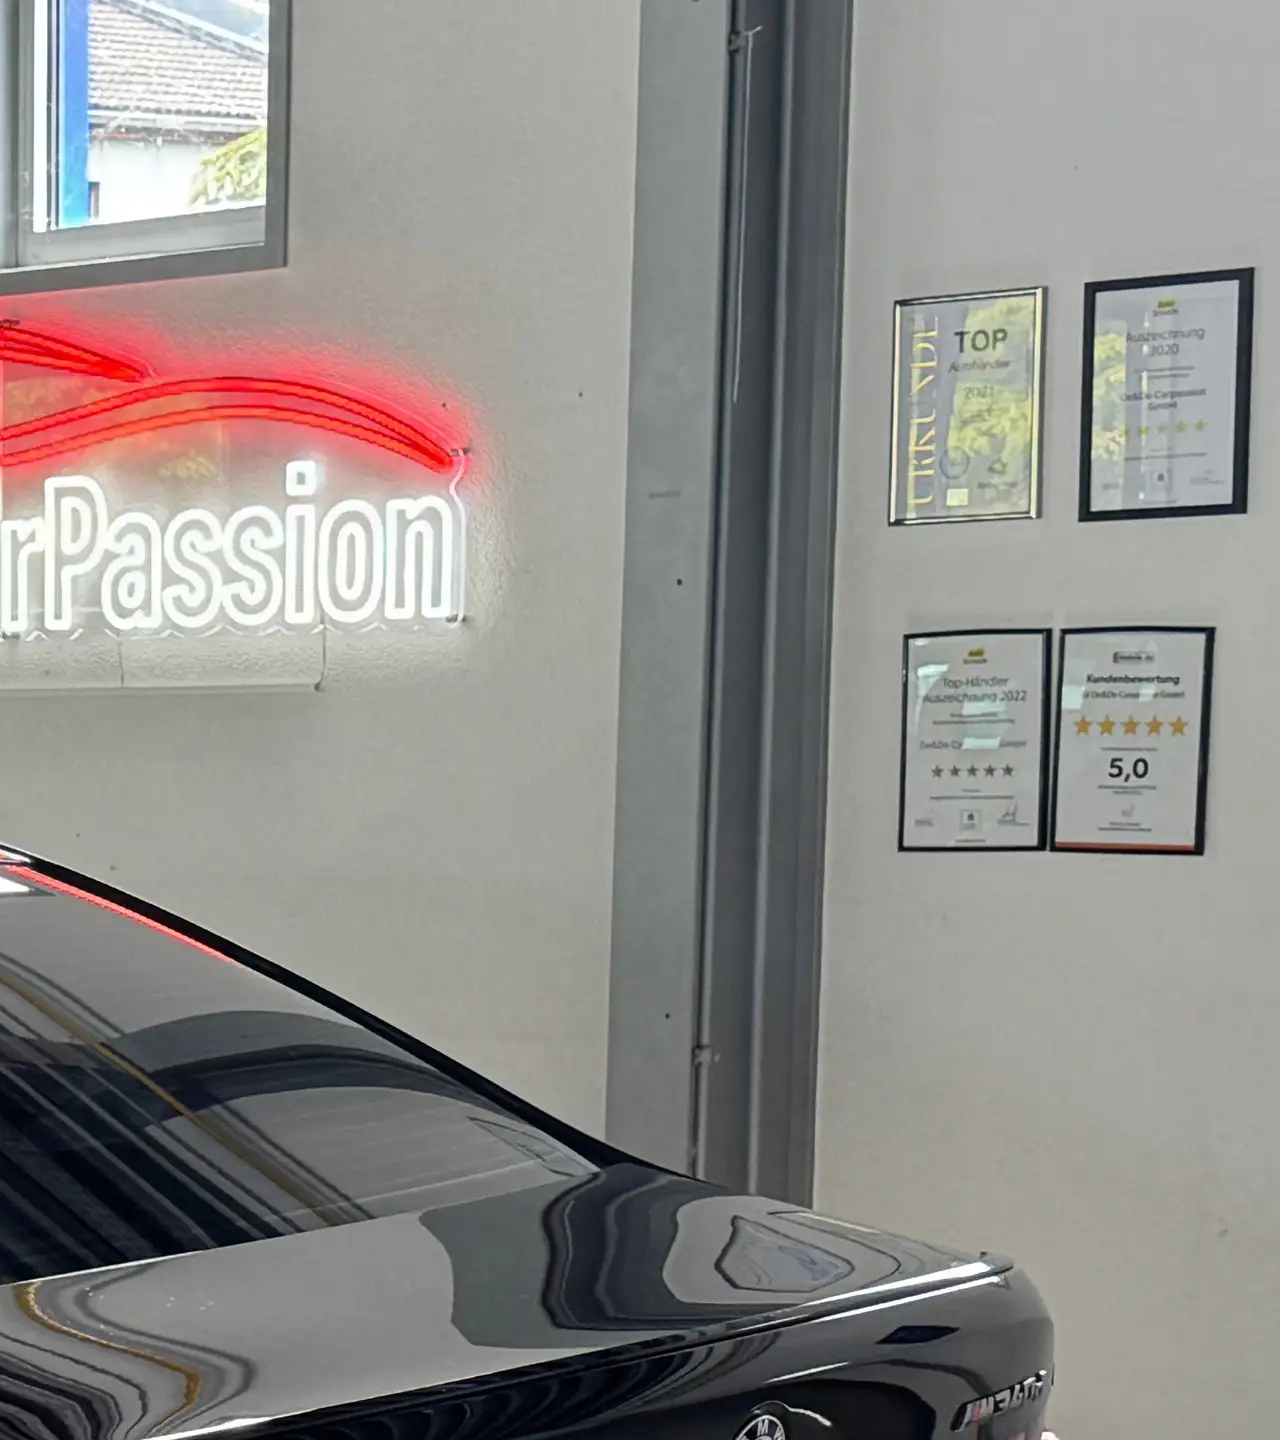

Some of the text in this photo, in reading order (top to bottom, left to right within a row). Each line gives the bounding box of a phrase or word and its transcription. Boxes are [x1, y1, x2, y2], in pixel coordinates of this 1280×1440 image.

[954, 328, 1008, 353] TOP
[1086, 674, 1181, 686] Kundenbewertung
[1107, 757, 1150, 783] 5,0
